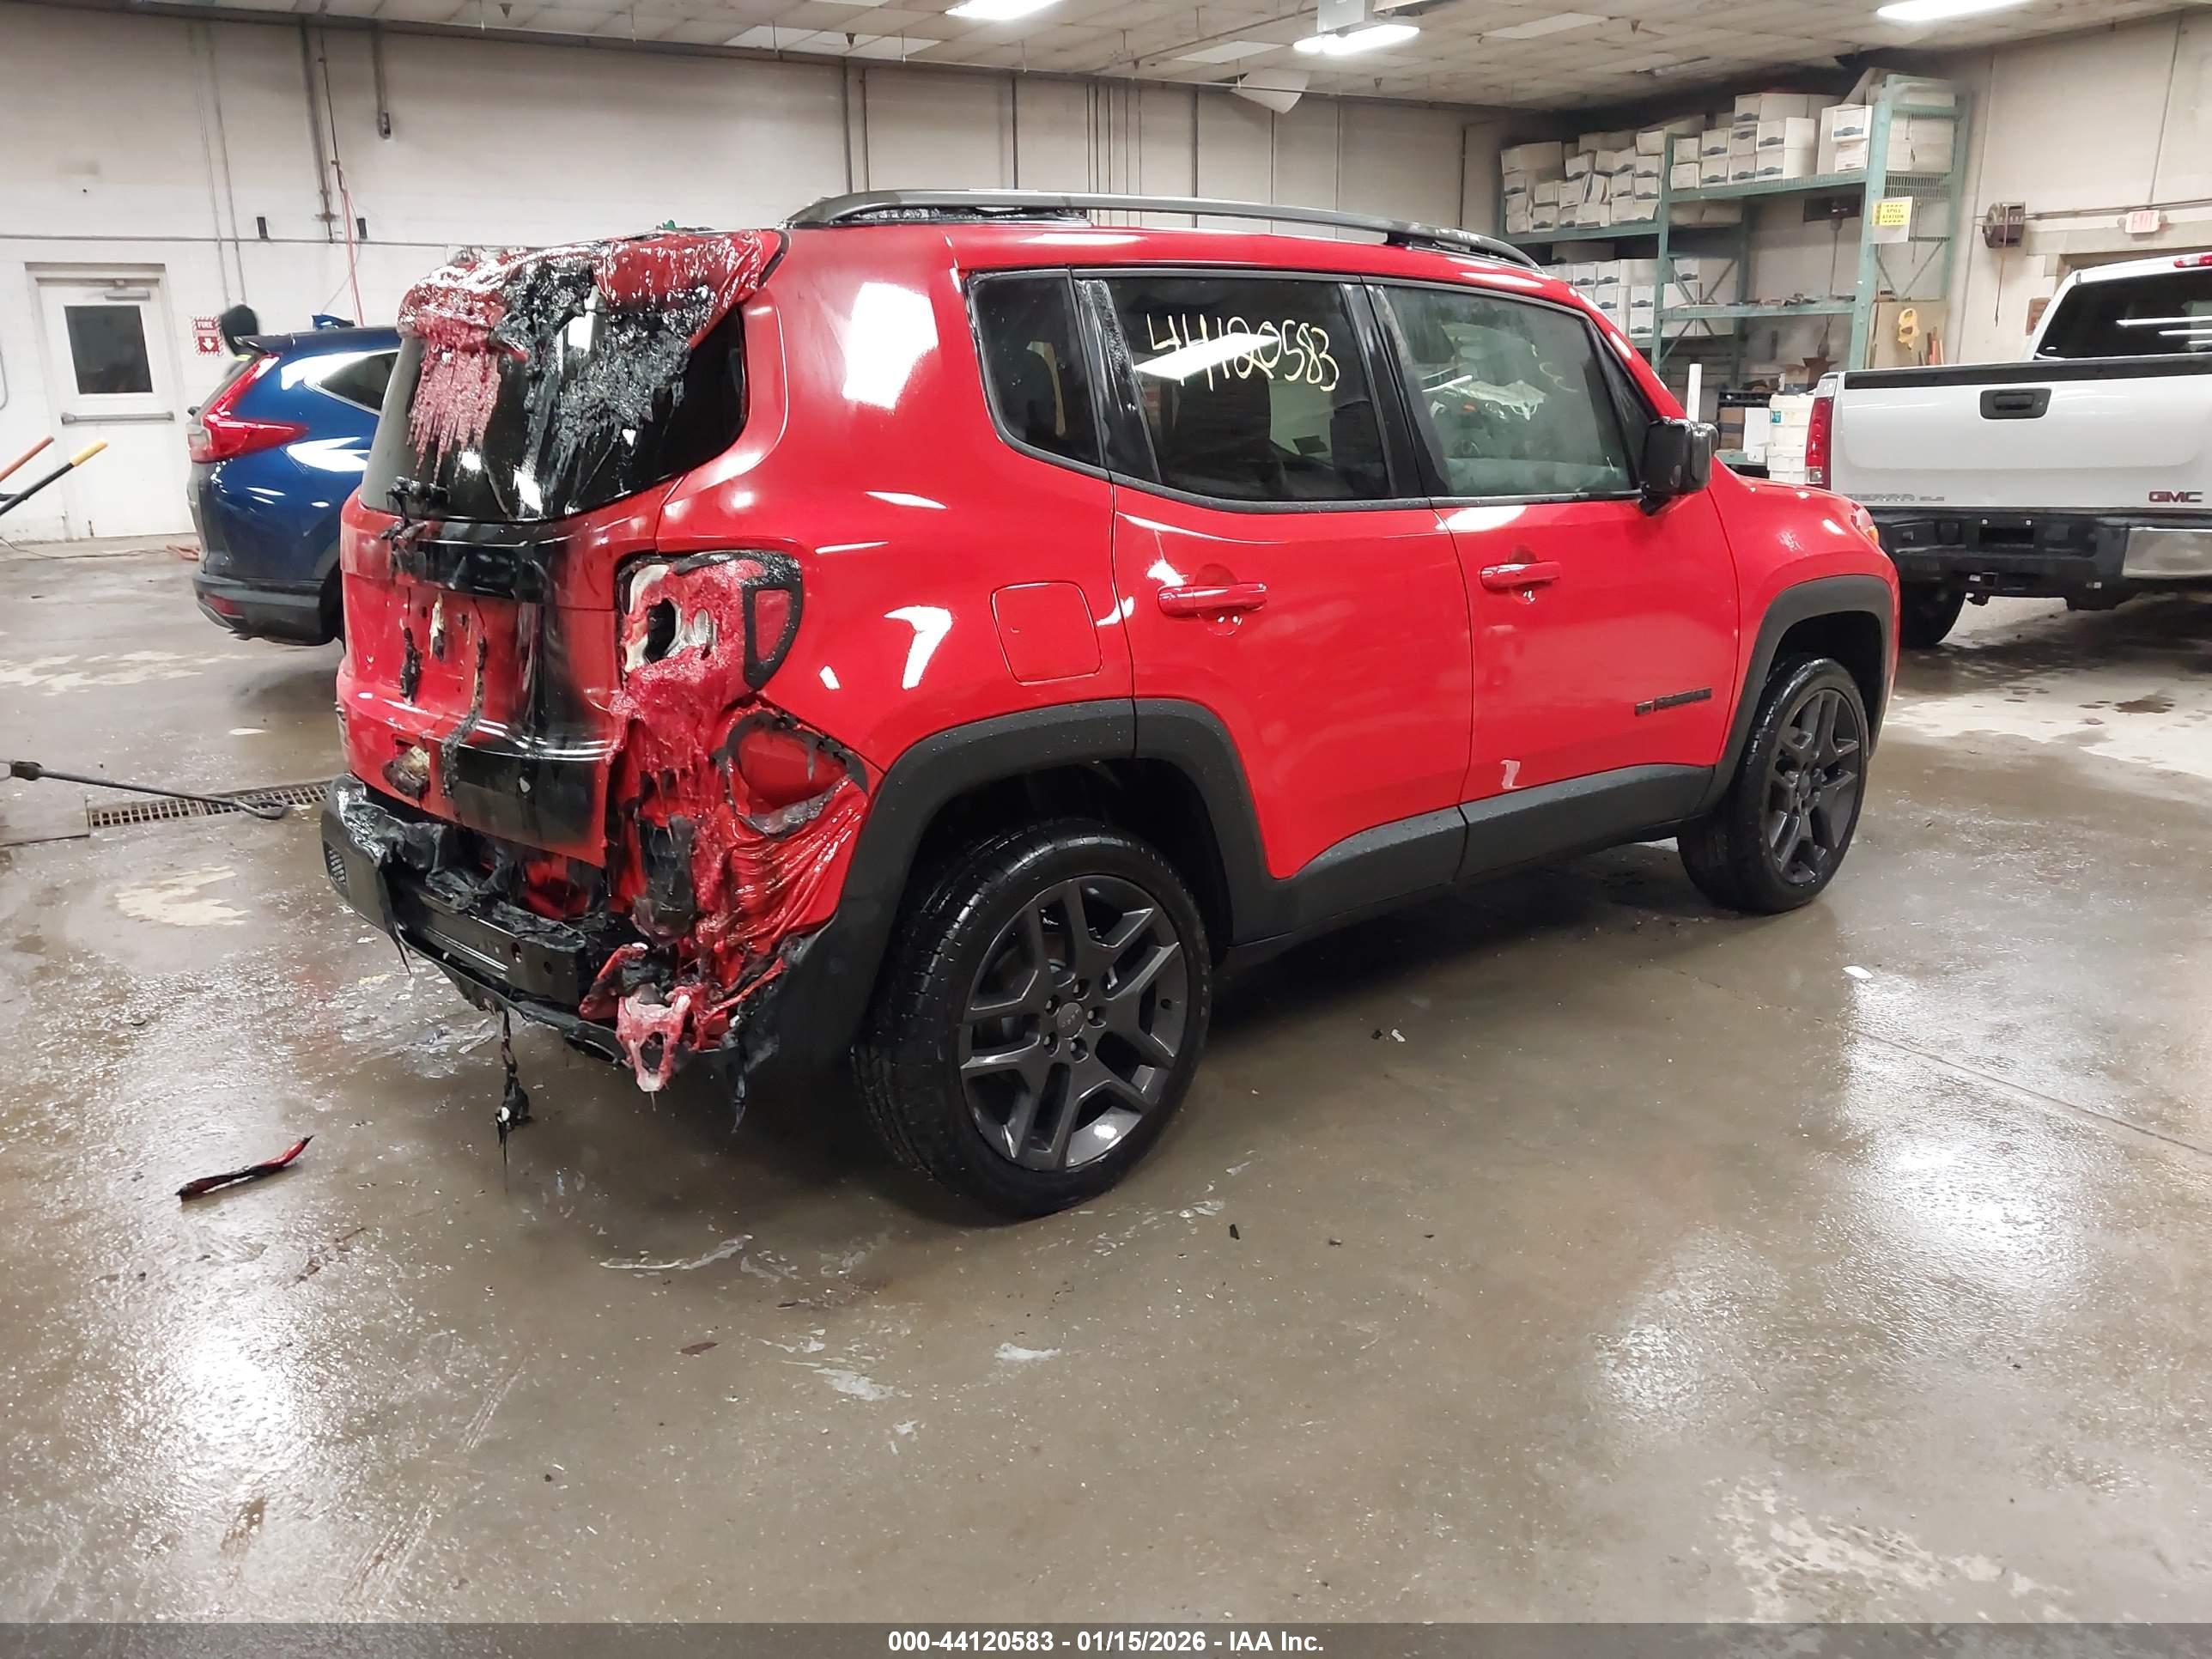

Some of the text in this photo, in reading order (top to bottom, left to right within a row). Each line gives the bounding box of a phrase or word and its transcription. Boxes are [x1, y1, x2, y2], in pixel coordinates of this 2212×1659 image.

[2130, 211, 2154, 229] EXIT
[197, 320, 214, 329] FIRE
[2148, 490, 2204, 503] GMC
